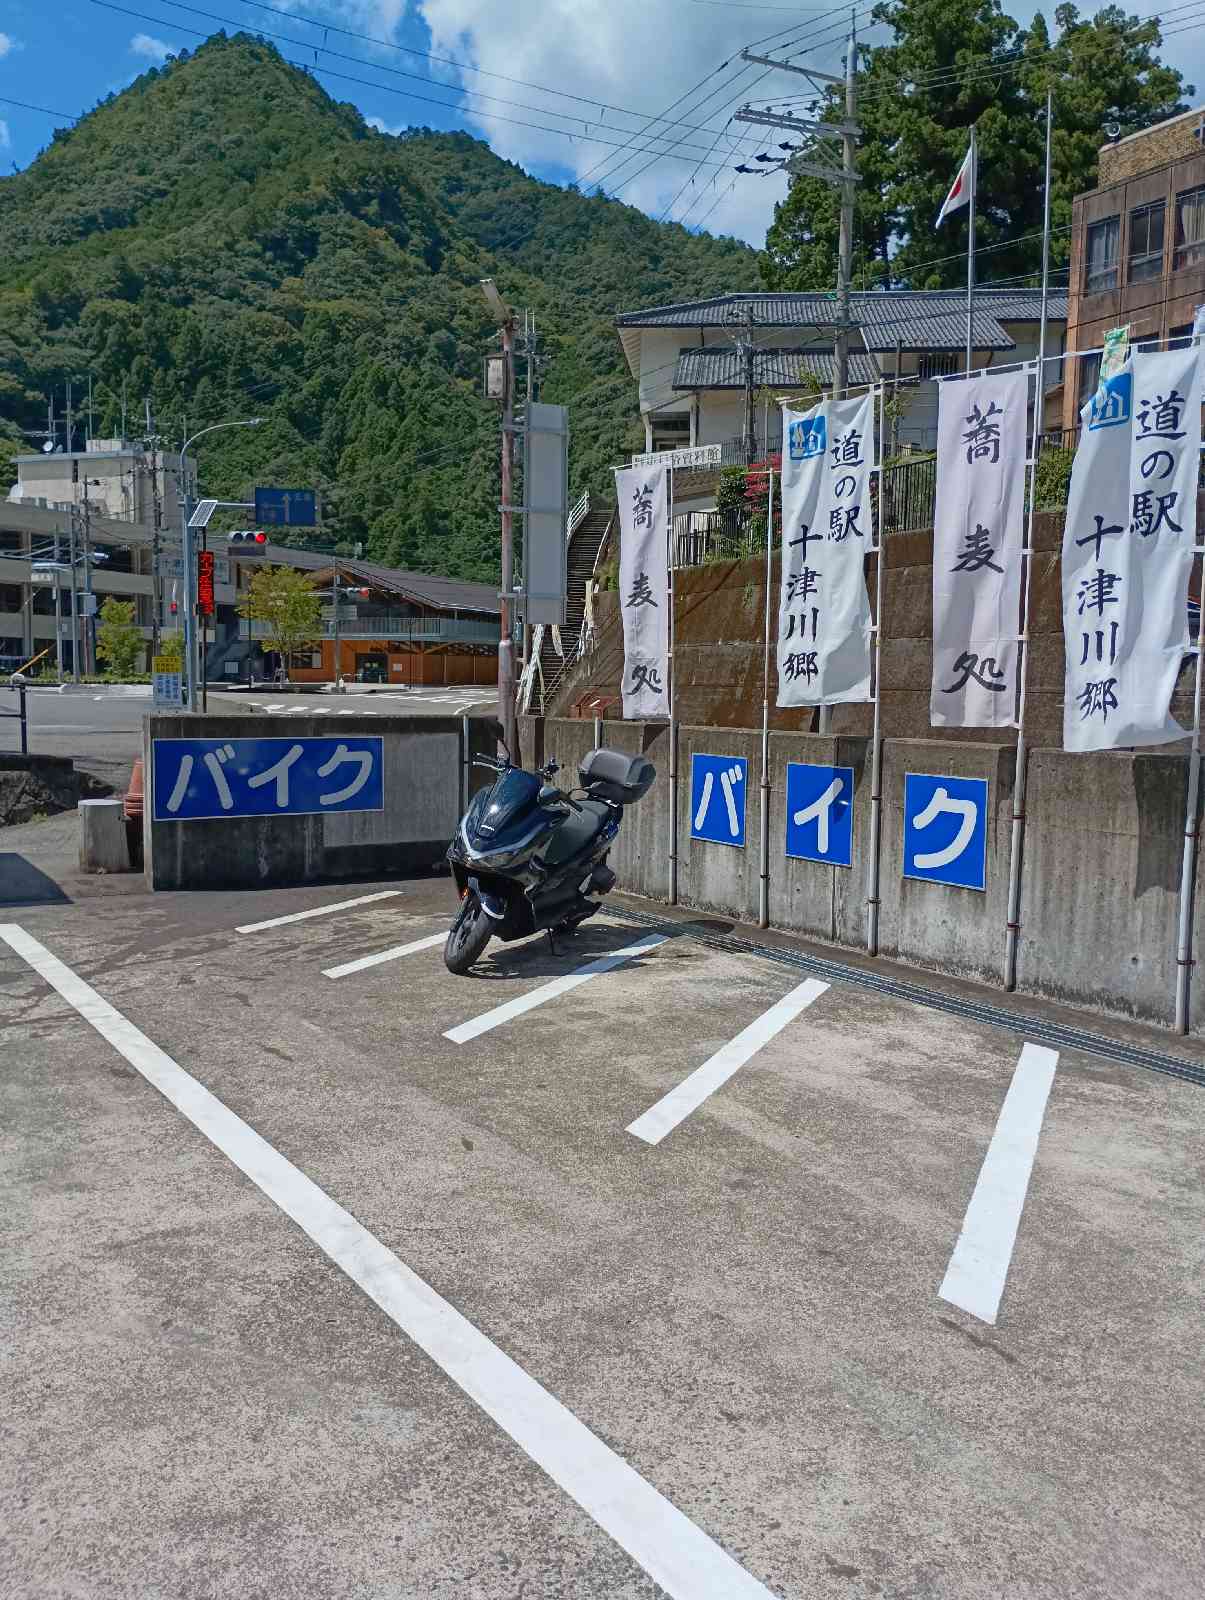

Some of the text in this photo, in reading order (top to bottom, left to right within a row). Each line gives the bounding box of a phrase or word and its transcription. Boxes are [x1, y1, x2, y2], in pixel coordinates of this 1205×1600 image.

[828, 429, 864, 542] 道の駅
[1130, 390, 1187, 537] 道の駅
[625, 484, 662, 695] 蕎麦処
[783, 524, 823, 686] 十津川郷
[941, 401, 1007, 693] 蕎麦処
[1075, 515, 1125, 725] 十津川郷
[166, 744, 374, 812] バイク
